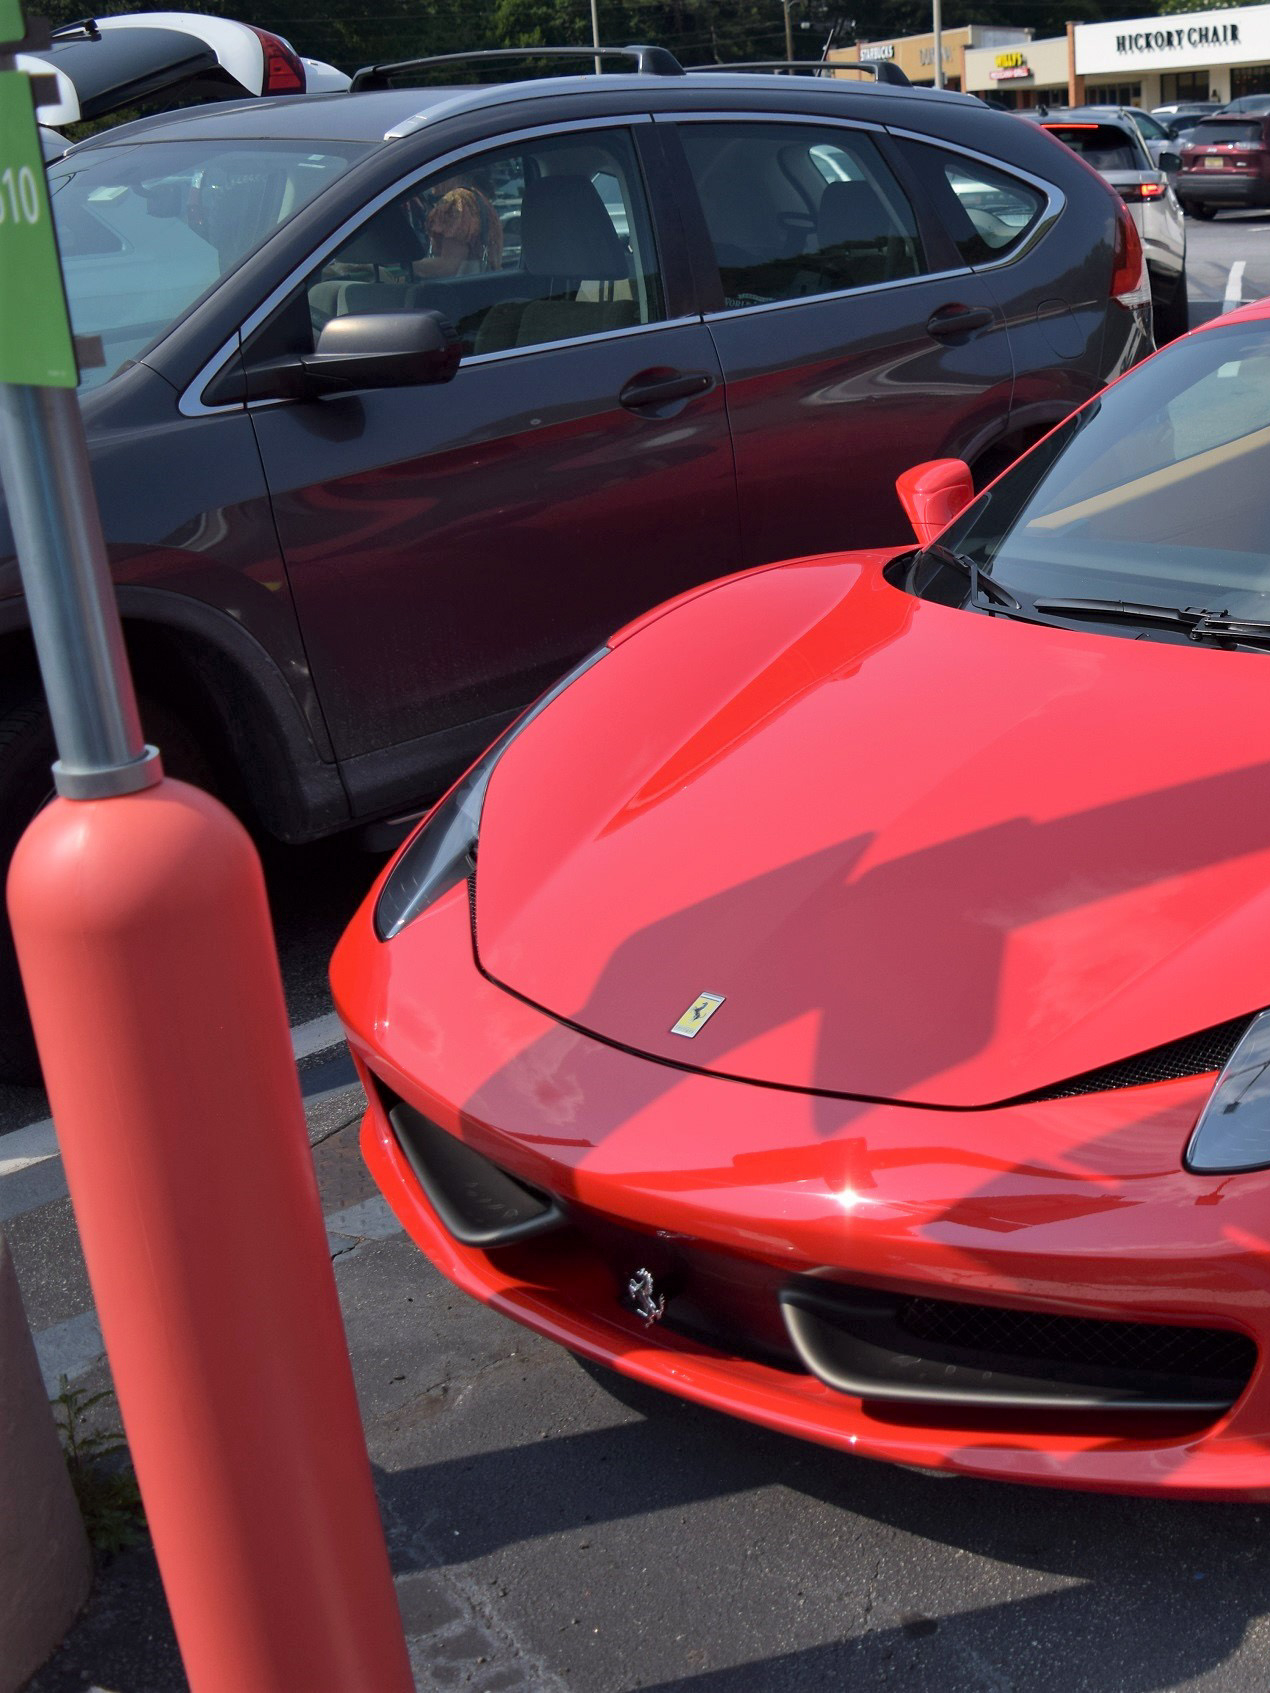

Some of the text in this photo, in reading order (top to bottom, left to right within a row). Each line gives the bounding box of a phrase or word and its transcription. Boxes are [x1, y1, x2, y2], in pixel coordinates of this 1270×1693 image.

[1116, 24, 1239, 52] HICKORY CHAIR
[0, 166, 39, 224] 10
